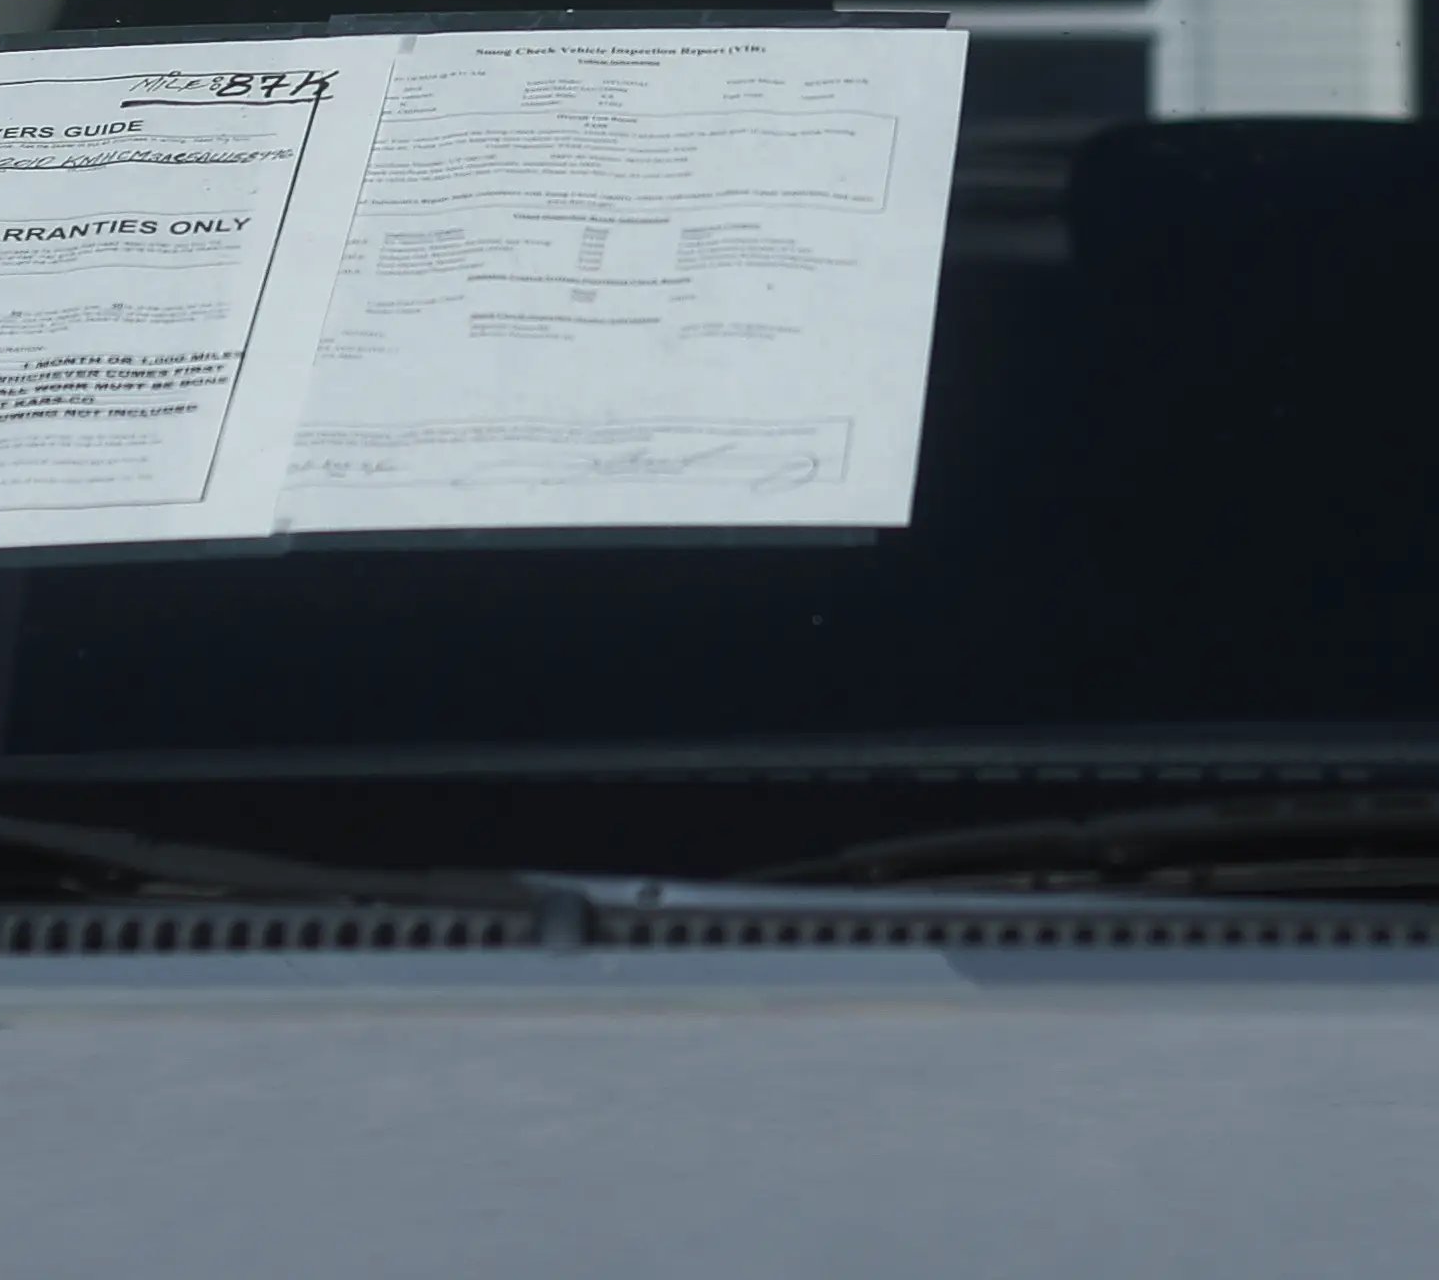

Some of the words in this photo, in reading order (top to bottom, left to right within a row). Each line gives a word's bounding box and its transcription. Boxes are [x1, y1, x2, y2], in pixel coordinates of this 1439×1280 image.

[476, 48, 512, 58] Smog
[515, 47, 556, 56] Check
[560, 46, 607, 55] Vehicle
[611, 46, 676, 57] Inspection
[680, 46, 725, 57] Report
[63, 120, 144, 138] GUIDE
[169, 216, 253, 236] ONLY
[35, 356, 101, 369] MONTH
[107, 355, 132, 365] OR
[106, 368, 169, 379] COMES
[173, 364, 226, 376] FIRST
[34, 382, 89, 392] WORK
[95, 381, 147, 391] MUST
[179, 375, 229, 387] DONE
[63, 409, 101, 418] NOT
[107, 404, 199, 417] INCLUDED
